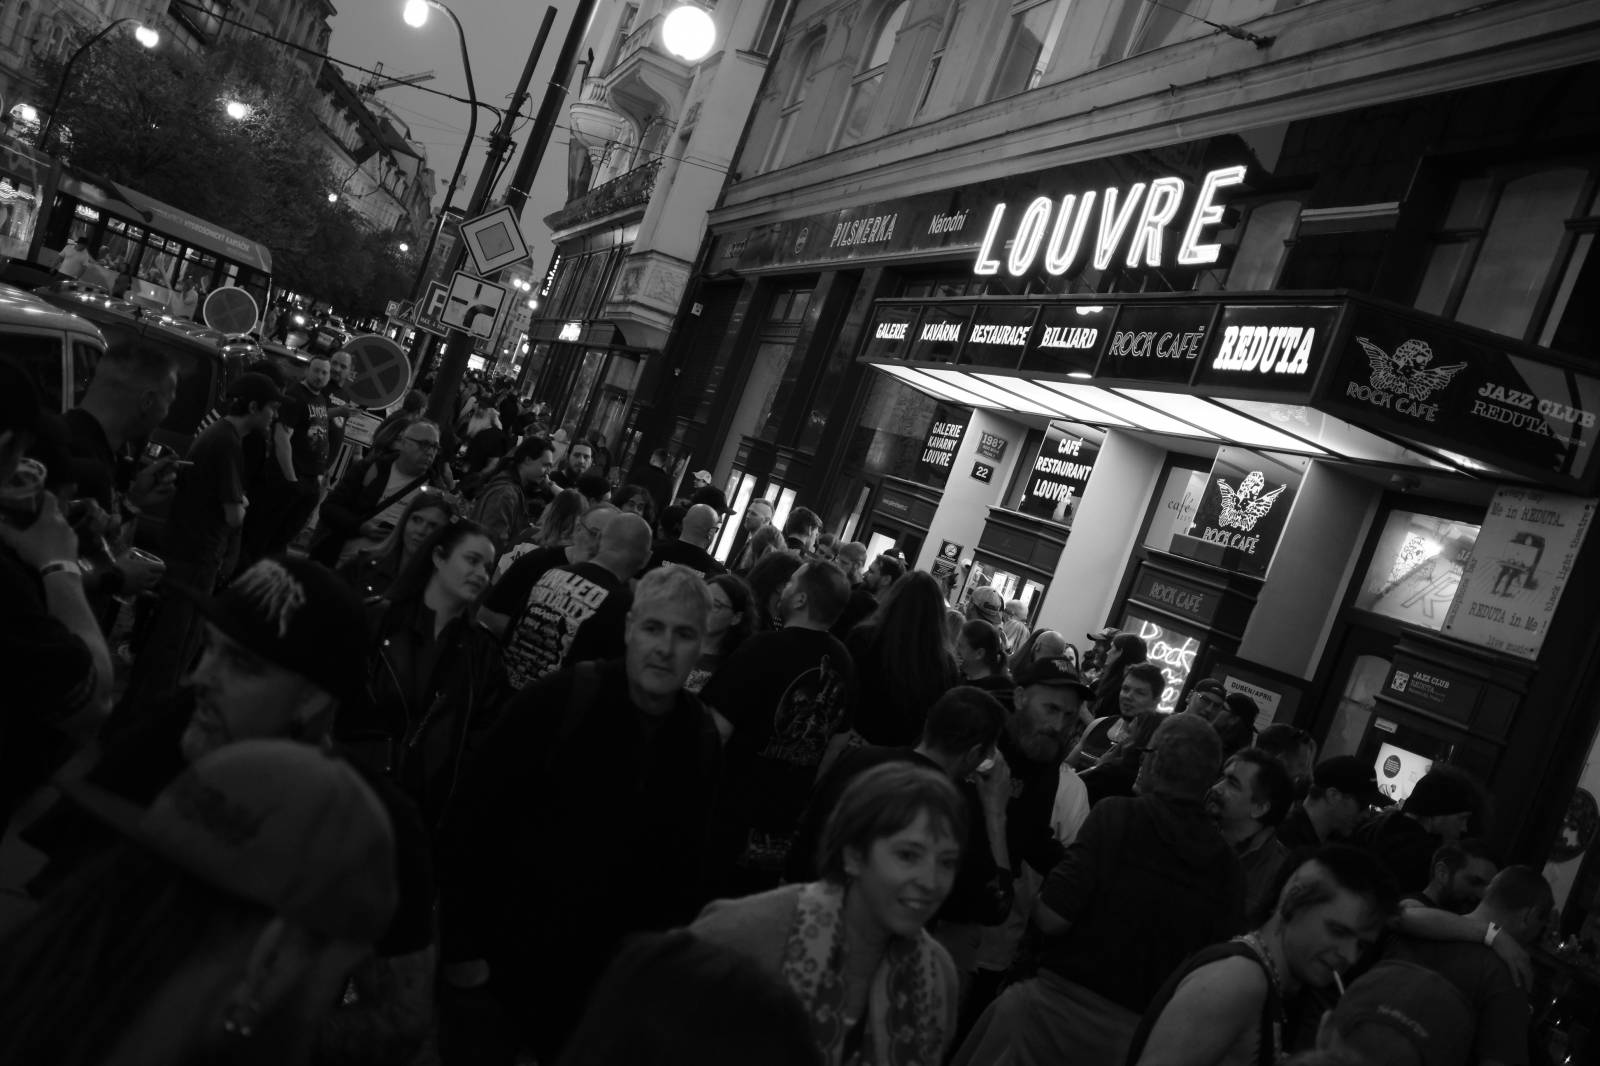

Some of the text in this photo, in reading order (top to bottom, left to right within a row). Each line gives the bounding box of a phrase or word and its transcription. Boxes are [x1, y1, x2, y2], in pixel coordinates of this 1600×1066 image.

[830, 213, 898, 248] PILSNERKA
[928, 208, 970, 234] Národní
[974, 165, 1247, 276] LOUVRE
[876, 321, 910, 341] GALERIE
[919, 320, 963, 343] KAVÁRNA
[968, 323, 1032, 346] RESTAURACE
[1037, 323, 1098, 349] BILLIARD
[1108, 331, 1156, 357] ROCK
[1212, 325, 1316, 374] REDUTA
[1346, 381, 1396, 409] ROCK
[1477, 381, 1596, 428] JAZZ CLUB
[932, 421, 963, 438] GALERIE
[1471, 399, 1551, 437] REDUTA
[927, 435, 958, 452] KAVÁRNY
[982, 433, 1005, 449] 1987
[1057, 438, 1083, 457] CAFÉ
[921, 448, 952, 468] LOUVRE
[1035, 456, 1092, 482] RESTAURANT
[975, 466, 989, 479] 22
[1033, 478, 1076, 503] LOUVRE
[1505, 504, 1518, 518] in
[1202, 526, 1232, 547] ROCK
[1149, 581, 1177, 605] ROCK
[1544, 584, 1560, 613] black
[1556, 552, 1575, 581] light
[1468, 601, 1507, 624] REDUTA
[1510, 613, 1522, 628] in
[1412, 671, 1450, 689] JAZZ CLUB
